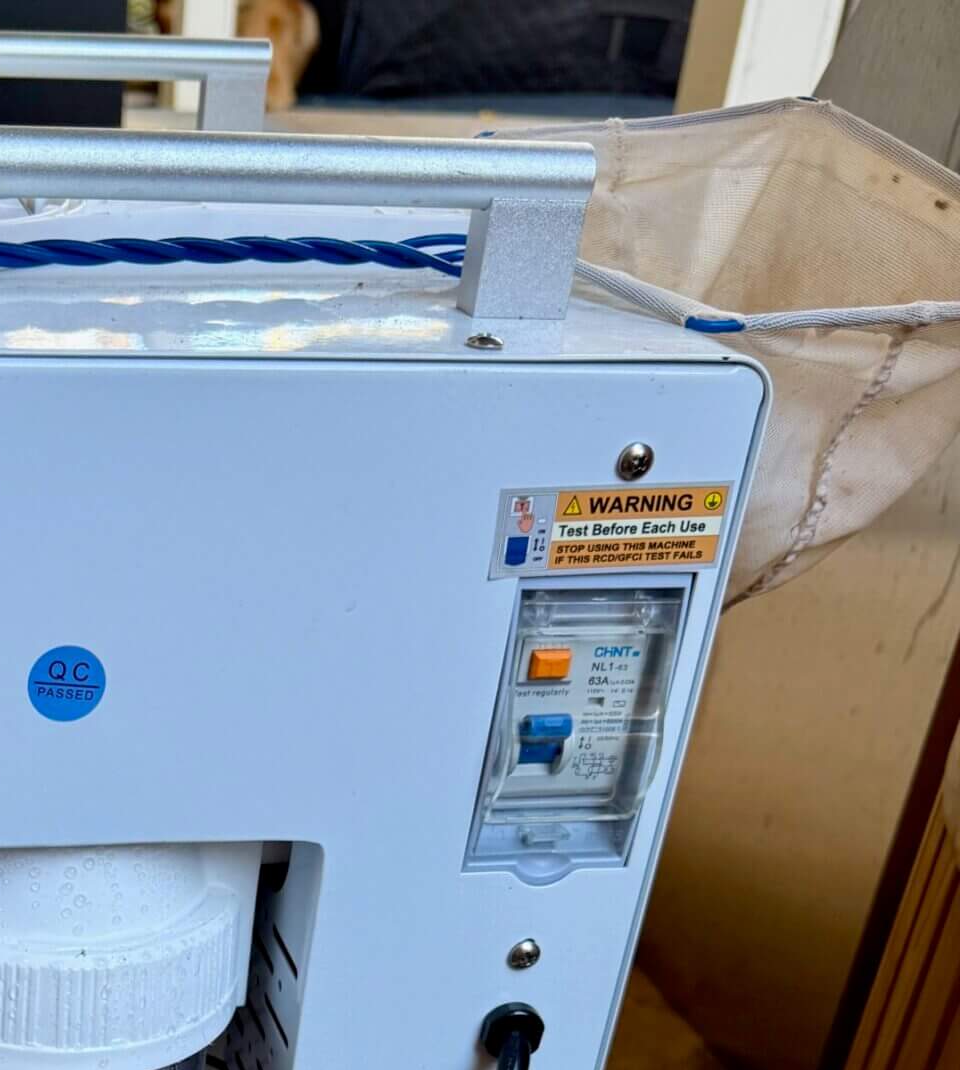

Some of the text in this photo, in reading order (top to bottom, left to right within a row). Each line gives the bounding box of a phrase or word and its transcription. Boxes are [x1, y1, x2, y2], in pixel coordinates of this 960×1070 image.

[589, 494, 693, 514] WARNING
[558, 525, 589, 538] Test
[592, 523, 637, 536] Before
[640, 522, 677, 535] Each
[680, 520, 706, 533] Use
[557, 540, 696, 554] STOP USING THIS MACHINE
[554, 556, 565, 565] IF
[567, 555, 591, 564] THIS
[593, 553, 643, 563] RCD/GFCI
[645, 552, 670, 561] TEST
[672, 550, 703, 560] FAILS
[37, 687, 94, 701] PASSED
